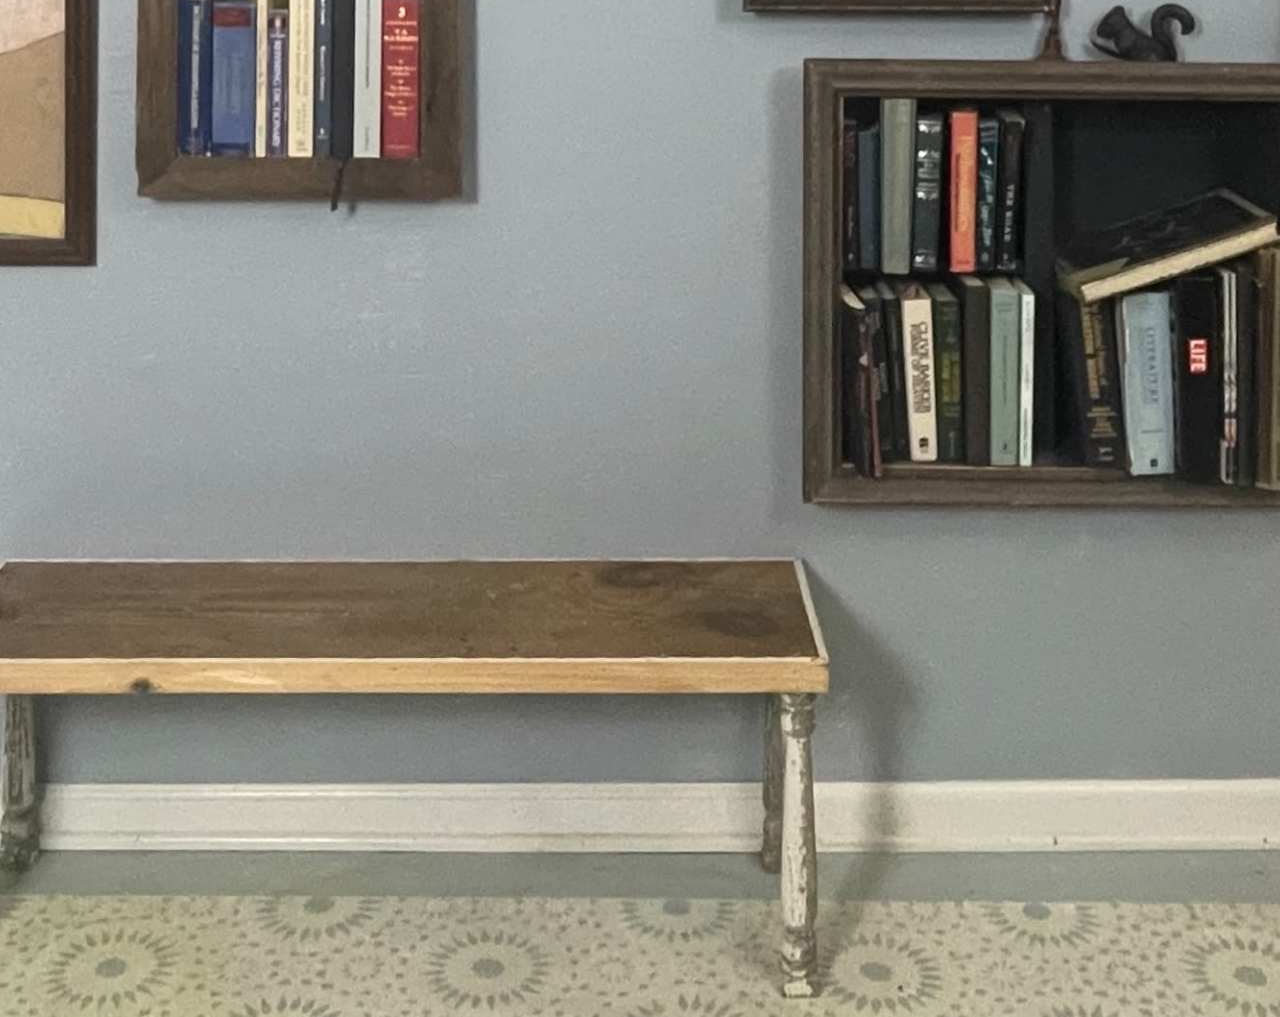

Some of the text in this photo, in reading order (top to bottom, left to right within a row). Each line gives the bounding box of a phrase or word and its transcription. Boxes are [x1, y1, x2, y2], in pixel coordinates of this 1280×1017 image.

[1005, 184, 1014, 206] THE
[918, 321, 932, 413] CLIVE BARKER
[1190, 338, 1207, 373] LIFE
